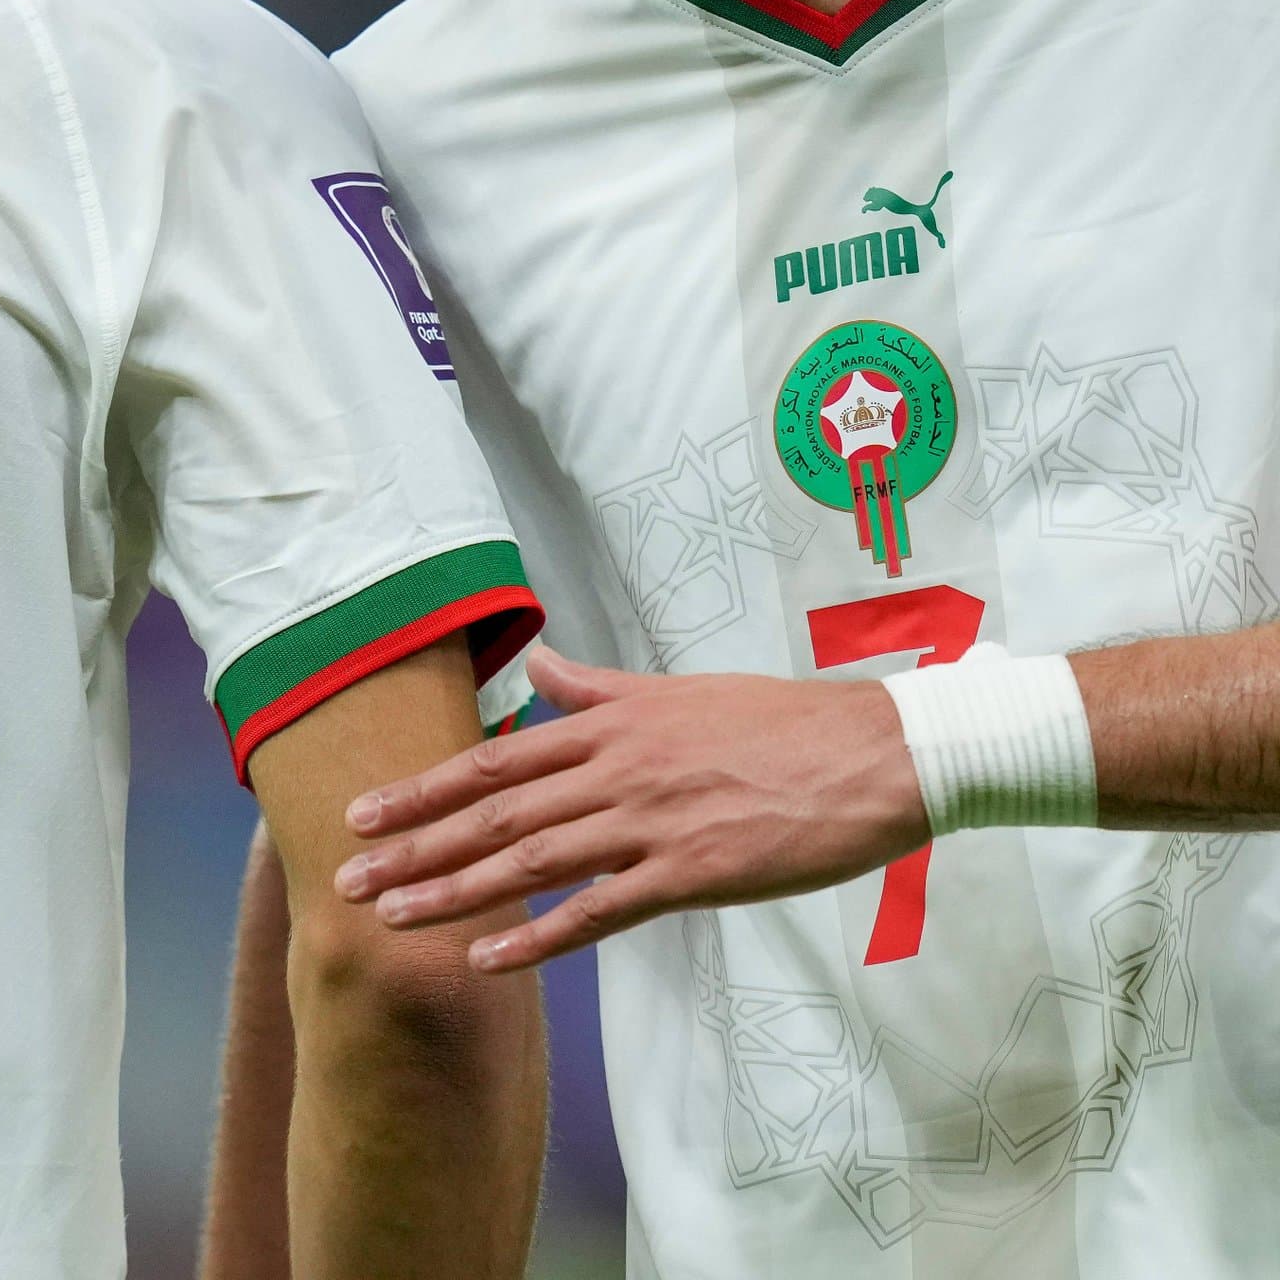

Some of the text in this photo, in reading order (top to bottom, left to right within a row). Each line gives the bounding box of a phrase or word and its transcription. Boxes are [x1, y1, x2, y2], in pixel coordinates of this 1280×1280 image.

[774, 226, 920, 303] PUMA
[409, 311, 431, 324] FIFA
[781, 327, 952, 478] الجامعة الملكية المغربية لكرة القدم
[805, 356, 923, 473] FEDERATION ROYALE MAROCAINE DE FOOTBALL
[854, 479, 897, 503] FRMF
[807, 584, 985, 966] 7
